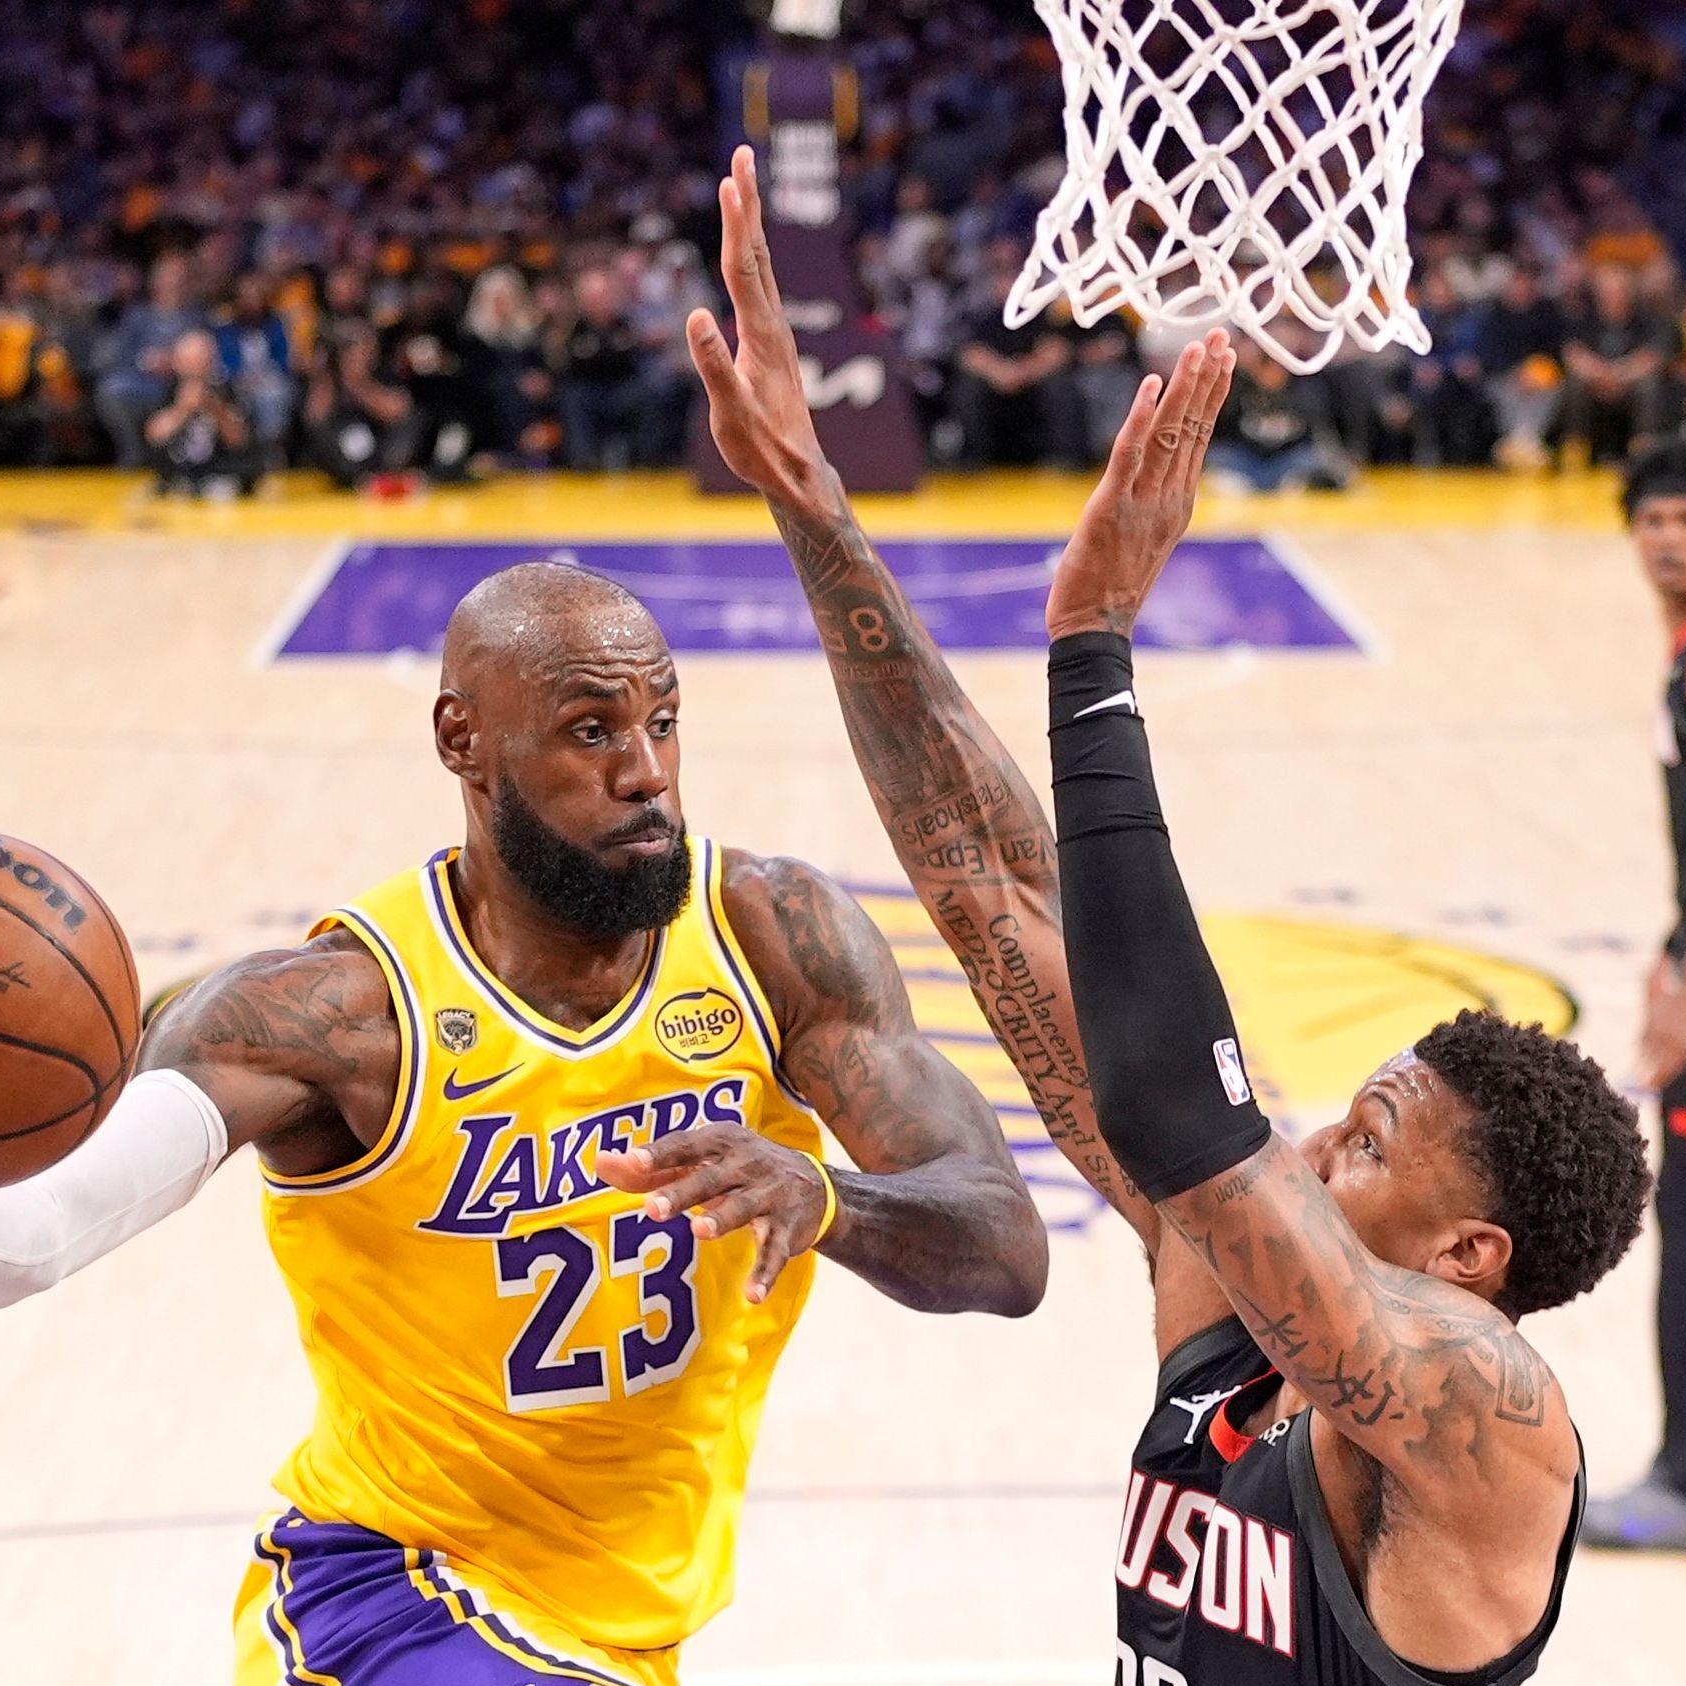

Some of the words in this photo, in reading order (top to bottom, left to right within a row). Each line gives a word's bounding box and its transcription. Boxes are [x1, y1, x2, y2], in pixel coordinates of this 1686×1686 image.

[661, 1008, 736, 1040] bibigo
[679, 1032, 711, 1049] 비비고
[931, 888, 1067, 1084] MEDIOCRITY
[1046, 1091, 1097, 1146] And
[492, 1209, 702, 1414] 23
